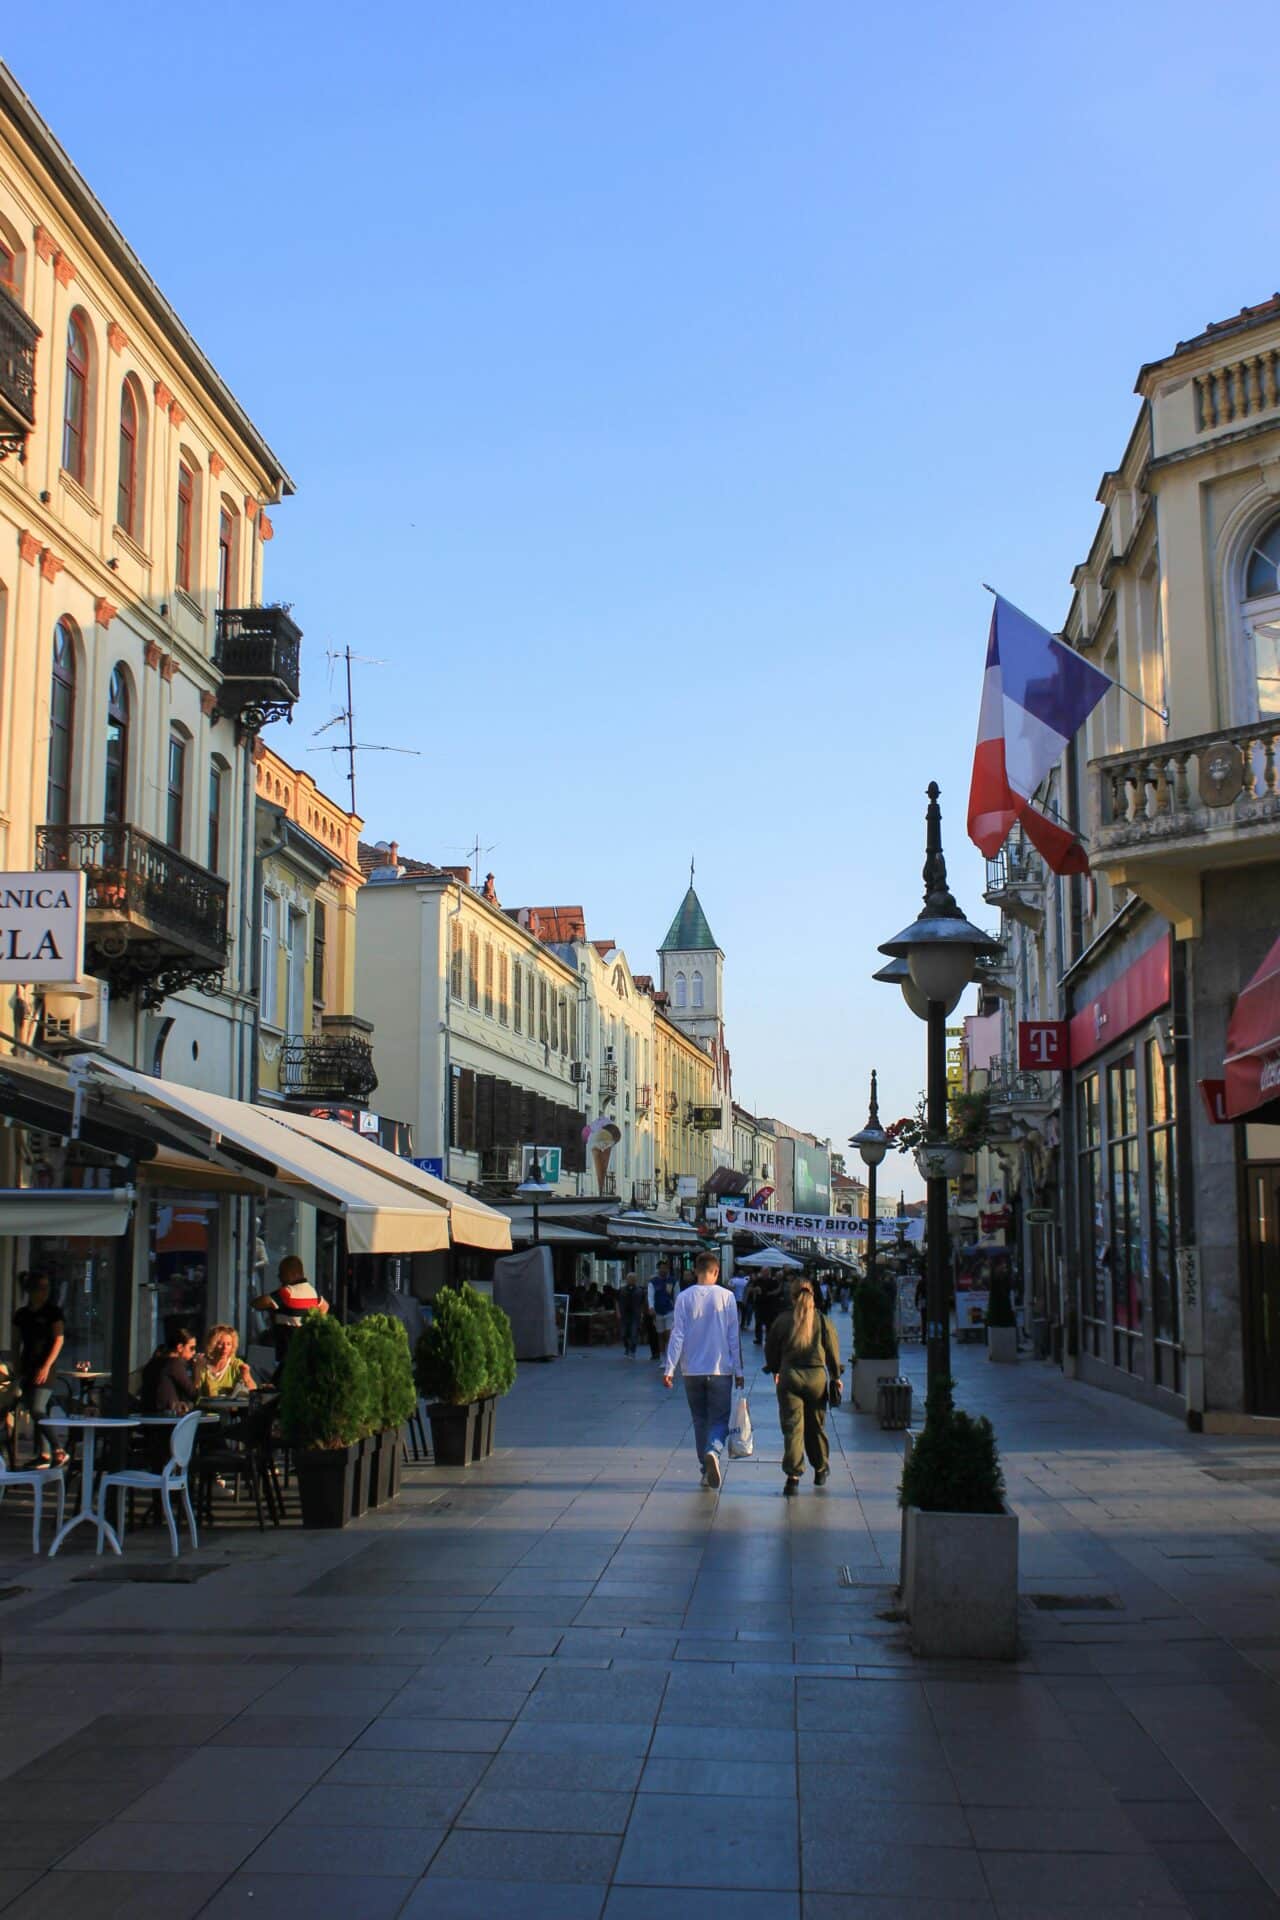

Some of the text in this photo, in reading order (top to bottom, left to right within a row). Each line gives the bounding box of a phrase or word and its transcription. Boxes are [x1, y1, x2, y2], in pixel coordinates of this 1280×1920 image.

[0, 929, 63, 960] LA
[1029, 1029, 1058, 1063] T
[744, 1211, 823, 1230] INTERFEST
[825, 1219, 868, 1232] BITOL
